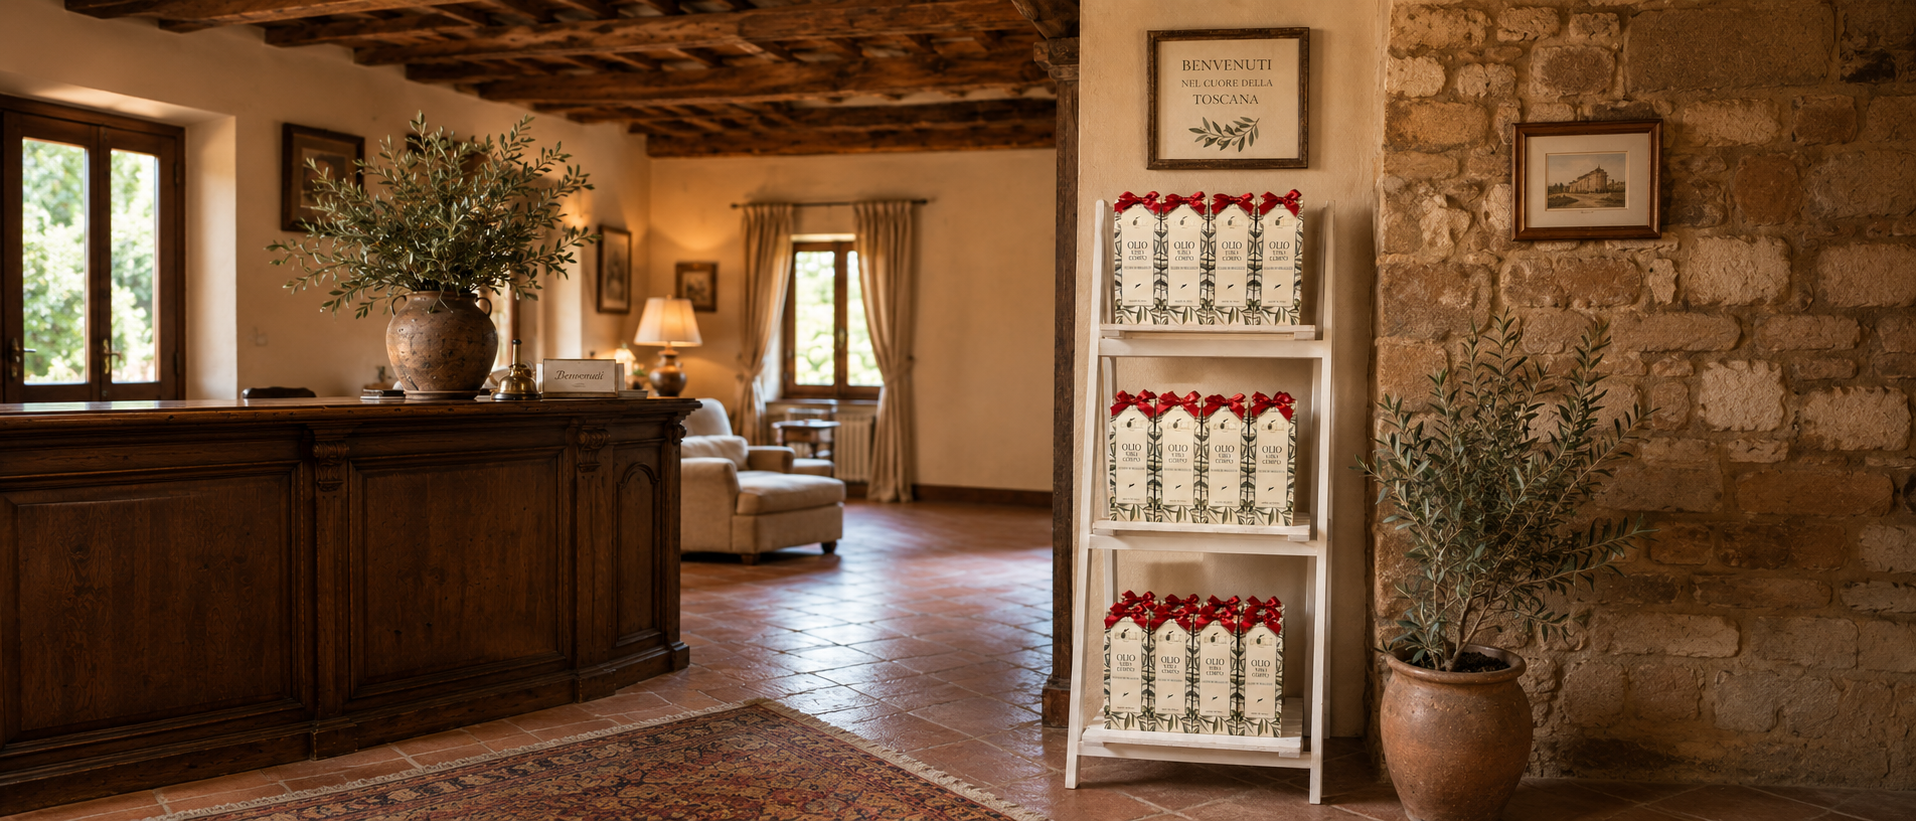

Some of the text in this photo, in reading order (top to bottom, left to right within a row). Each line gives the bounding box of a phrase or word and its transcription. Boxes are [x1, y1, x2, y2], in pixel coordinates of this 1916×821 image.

[1182, 59, 1272, 71] BENVENUTI
[1181, 78, 1273, 88] NEL CUORE DELLA
[1192, 94, 1259, 105] TOSCANA
[1127, 241, 1148, 250] OLIO
[1174, 241, 1196, 250] OLIO
[1222, 241, 1242, 250] OLIO
[1269, 241, 1290, 250] OLIO
[1122, 443, 1142, 451] OLIO
[1168, 444, 1188, 452] OLIO
[1161, 656, 1180, 664] OLIO
